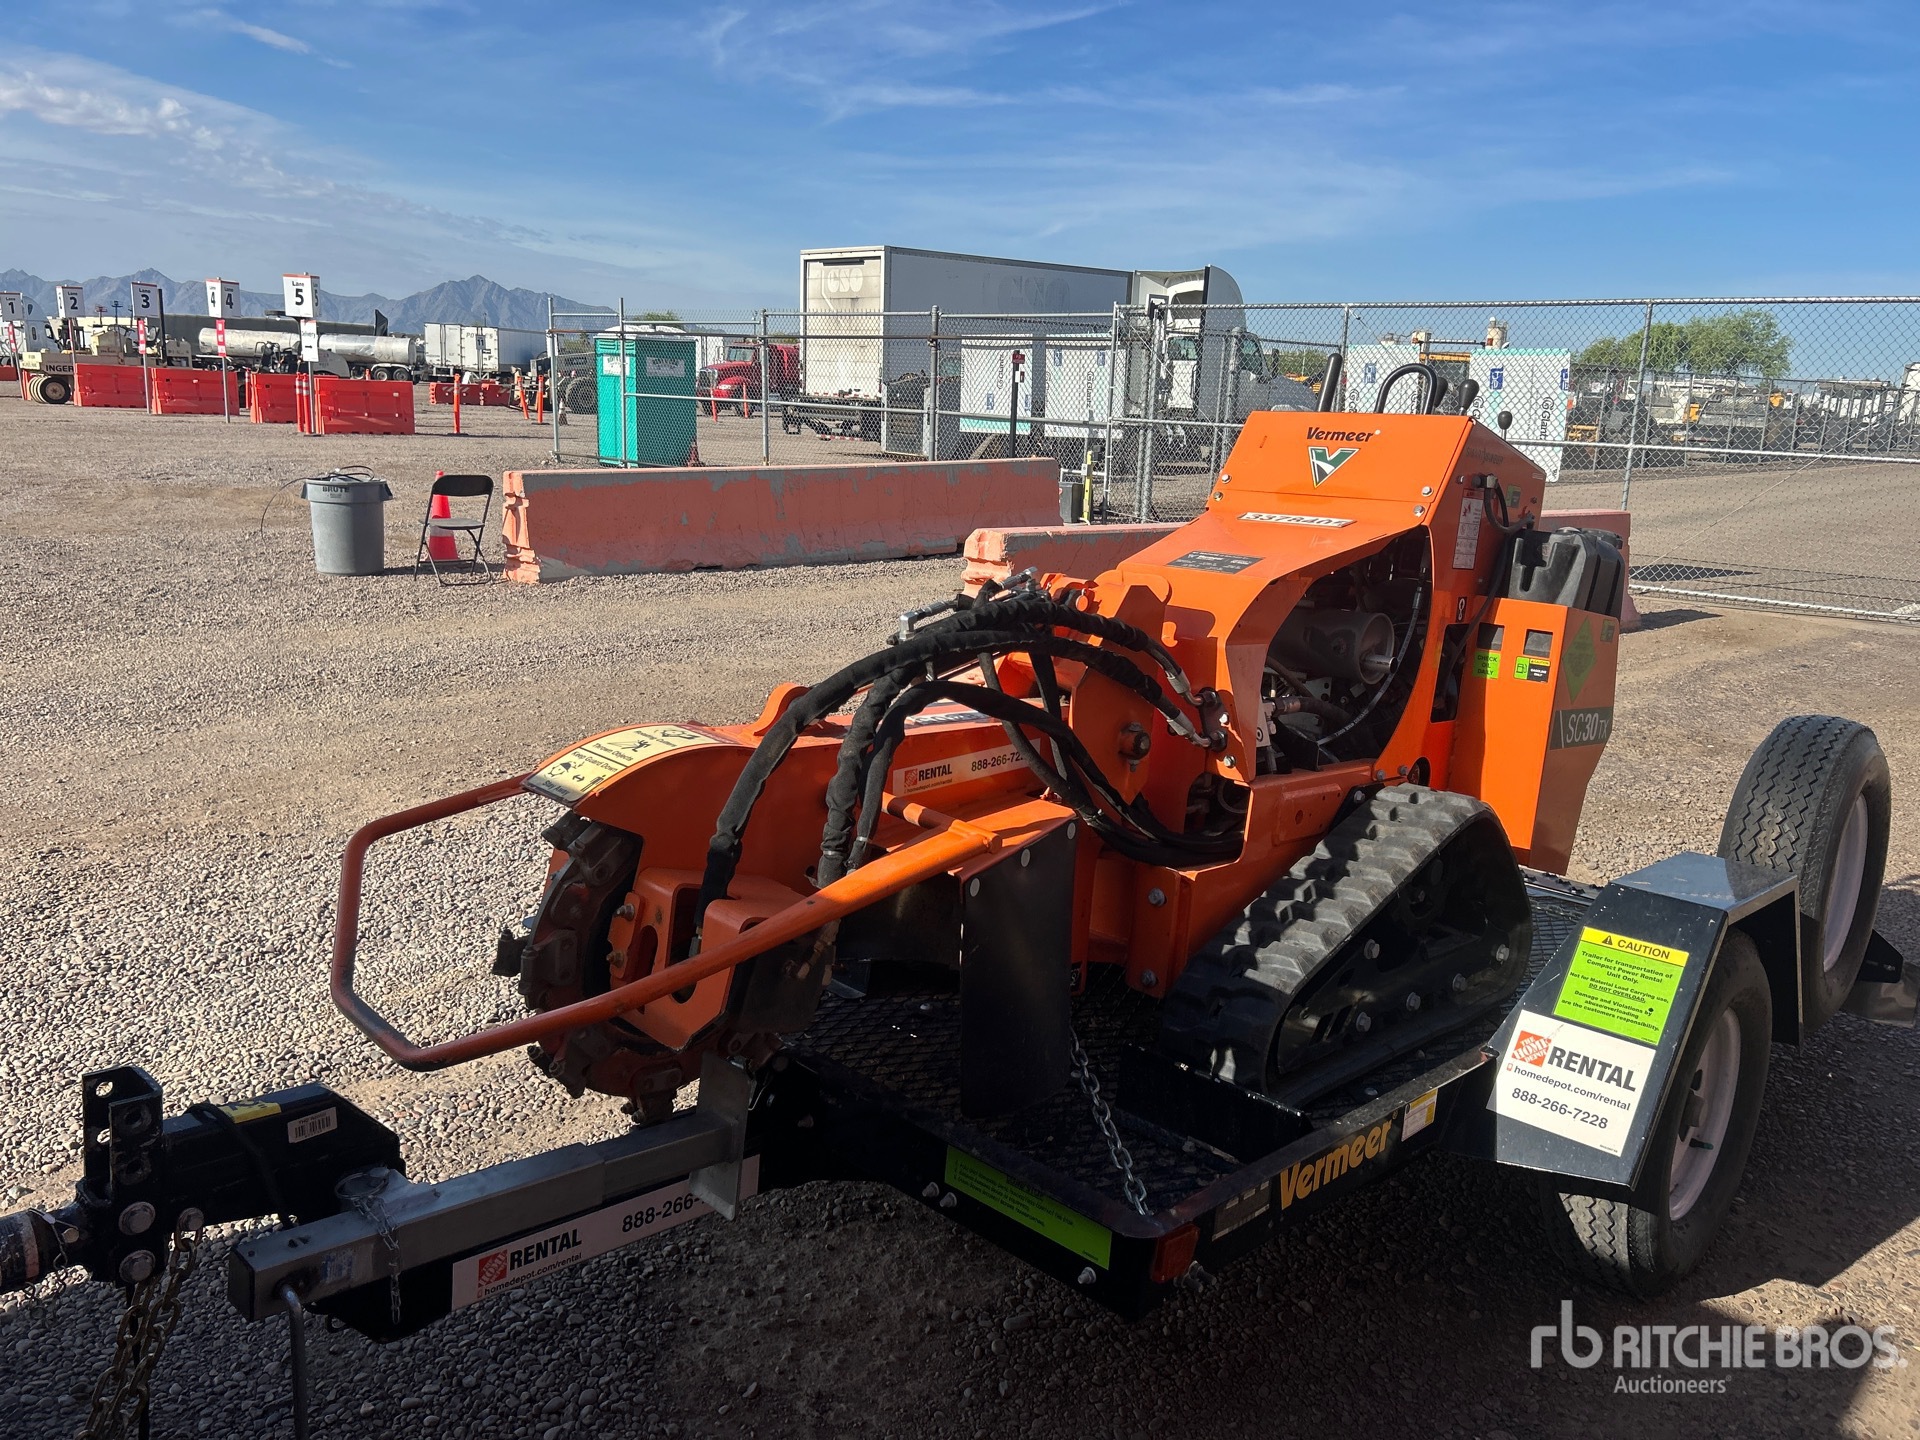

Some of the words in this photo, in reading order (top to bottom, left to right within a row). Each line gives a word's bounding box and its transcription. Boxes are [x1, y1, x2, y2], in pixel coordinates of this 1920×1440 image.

[70, 297, 78, 310] 2
[141, 294, 150, 308] 3
[210, 292, 216, 308] 4
[226, 293, 234, 309] 4
[295, 288, 304, 306] 5
[8, 302, 14, 314] 1
[1307, 427, 1374, 442] Vermeer
[572, 751, 585, 760] Keep
[585, 756, 602, 767] Guard
[602, 763, 618, 772] Down
[612, 750, 633, 761] Objects
[918, 764, 952, 782] RENTAL
[971, 752, 1024, 772] 888-266-72
[1617, 939, 1670, 959] CAUTION
[1582, 951, 1603, 961] Trailer
[1615, 958, 1664, 976] transportation
[1587, 959, 1616, 972] Compact
[1618, 966, 1638, 976] Power
[1640, 973, 1662, 983] Rental
[1590, 977, 1613, 988] Material
[1615, 984, 1628, 992] Load
[1630, 987, 1655, 1000] Carrying
[1622, 975, 1638, 984] Only.
[1575, 990, 1598, 1001] Damage
[1613, 1000, 1642, 1013] Violations
[1584, 1005, 1615, 1018] customers
[1548, 1046, 1637, 1092] RENTAL
[1514, 1065, 1631, 1111] homedepot.com/rental
[1512, 1087, 1608, 1130] 888-266-7228
[1280, 1119, 1392, 1210] Vermeer
[509, 1228, 582, 1271] RENTAL
[622, 1192, 704, 1233] 888-266-
[484, 1253, 582, 1296] homedepot.com/rental
